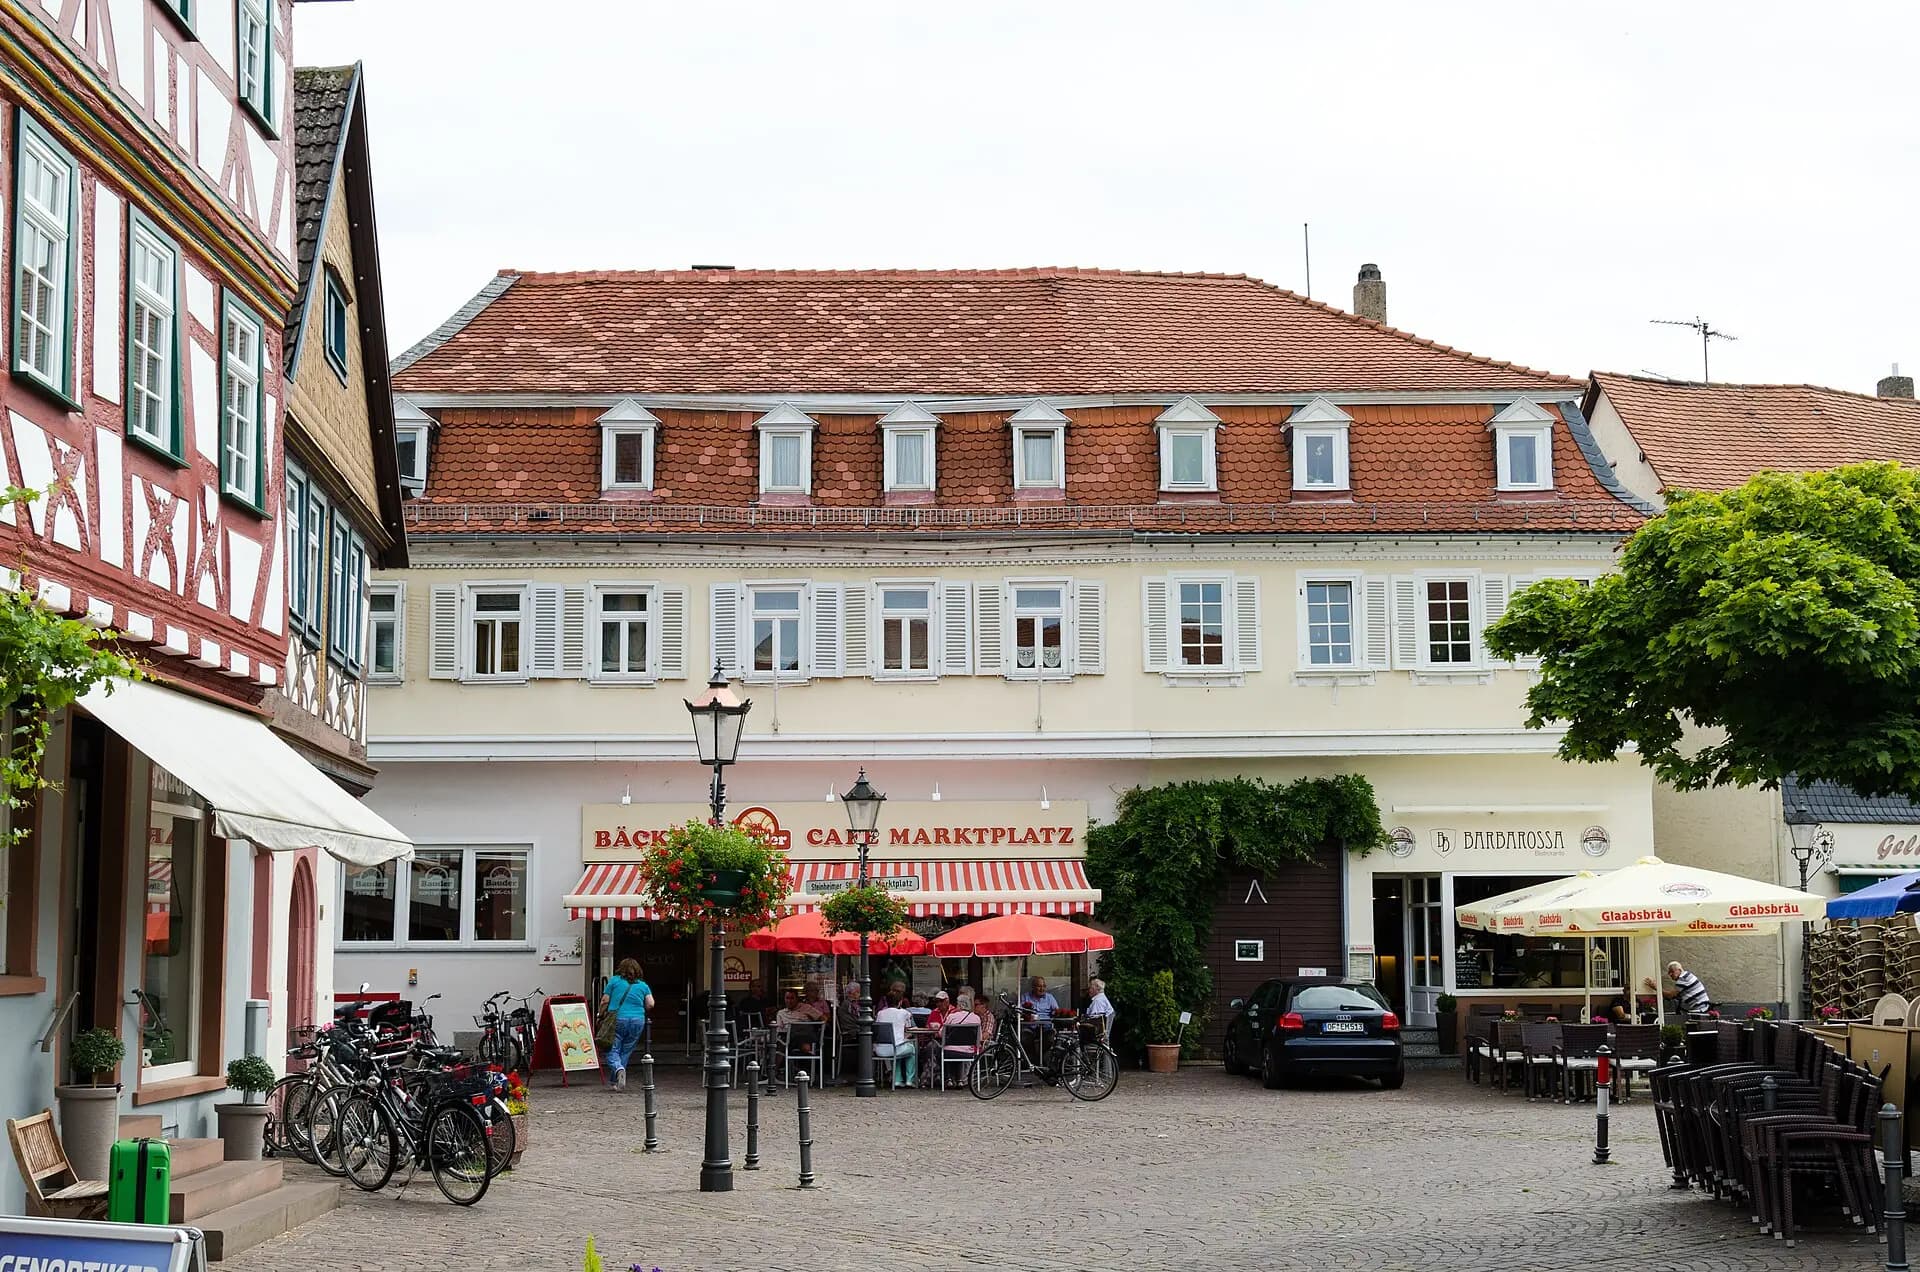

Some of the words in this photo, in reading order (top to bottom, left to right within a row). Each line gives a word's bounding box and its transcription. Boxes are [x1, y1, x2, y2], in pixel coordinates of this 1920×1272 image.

[594, 826, 668, 848] BÄCK
[890, 827, 1074, 846] MARKTPLATZ
[1464, 830, 1565, 850] BARBAROSSA
[420, 879, 453, 888] Bauder
[485, 878, 517, 887] Bauder
[810, 882, 842, 891] Steinheimer
[875, 879, 913, 889] Marktplatz
[1601, 908, 1672, 921] Glaabsbräu
[1729, 903, 1800, 916] Glaabsbräu
[724, 971, 751, 981] uder
[0, 1255, 159, 1272] GENOPT
